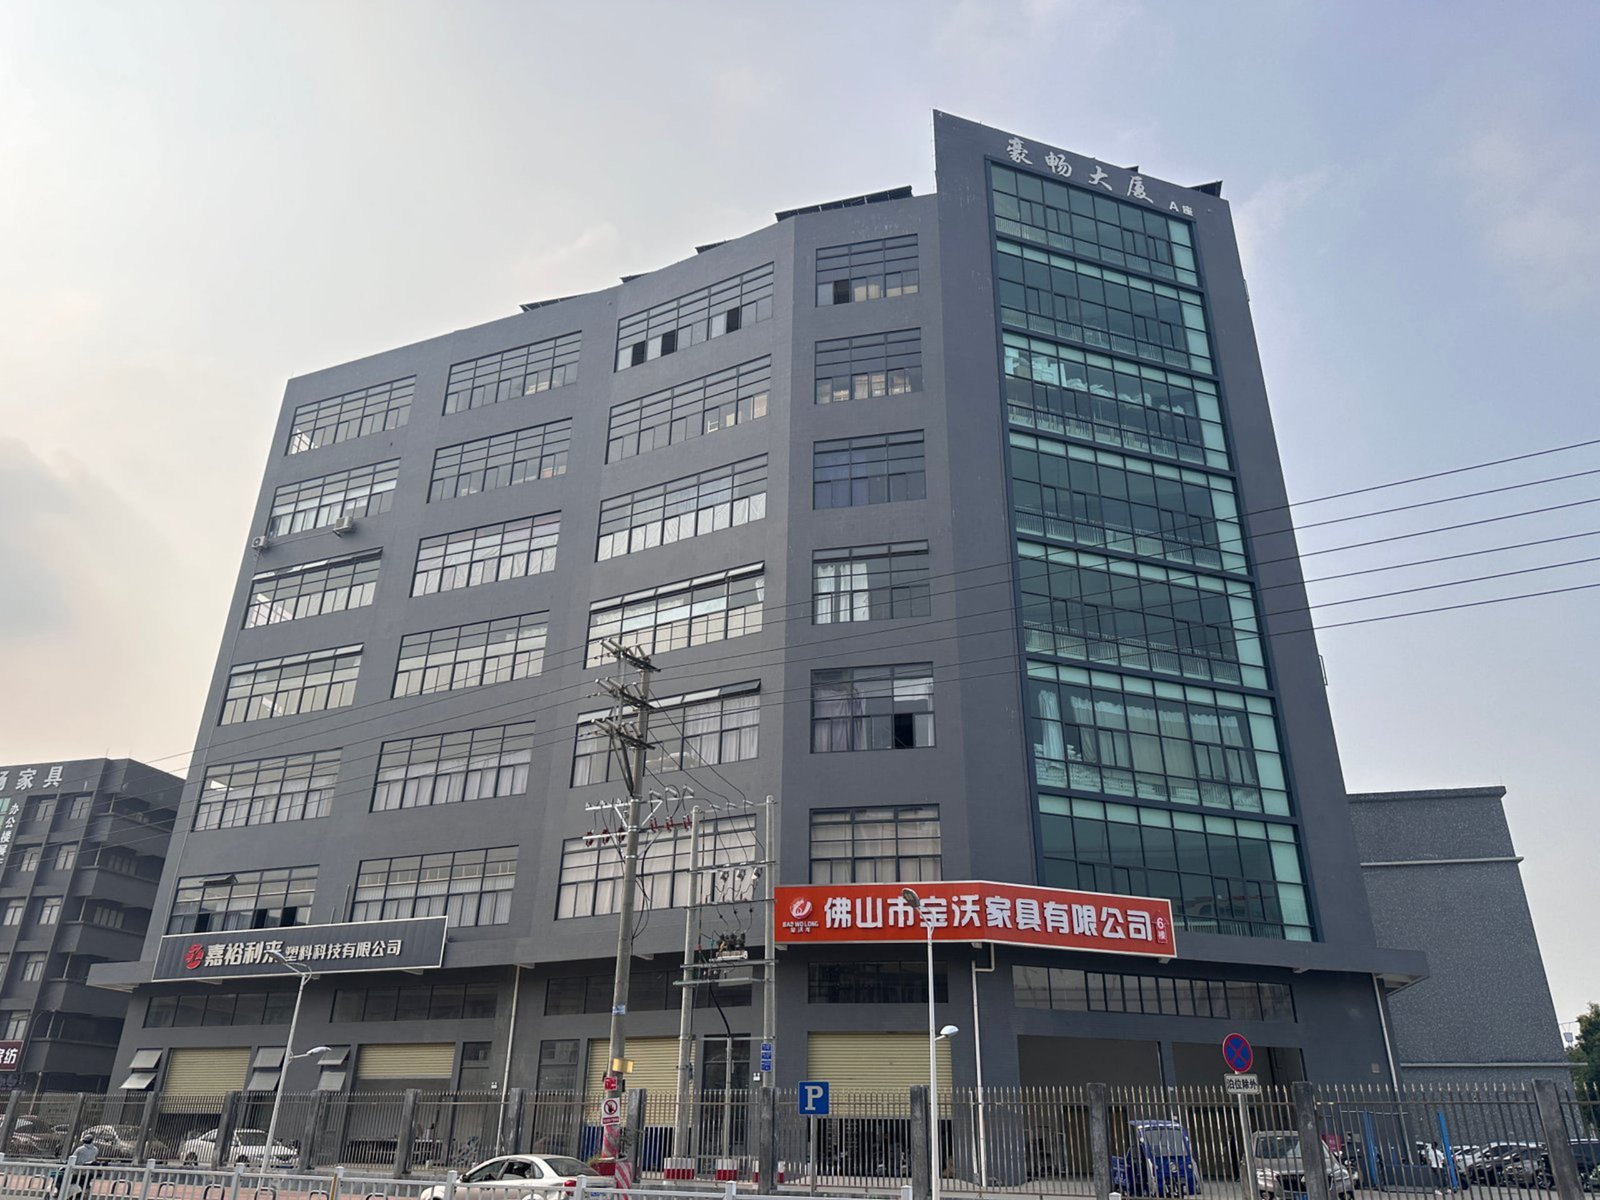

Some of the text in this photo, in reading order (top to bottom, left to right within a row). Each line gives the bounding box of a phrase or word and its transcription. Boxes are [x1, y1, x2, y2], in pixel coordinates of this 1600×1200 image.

[1007, 137, 1154, 204] 豪畅大厦
[824, 895, 1152, 941] 佛山市宝沃家具有限公司
[804, 1085, 824, 1111] P
[1227, 1078, 1258, 1090] 泊位除外
